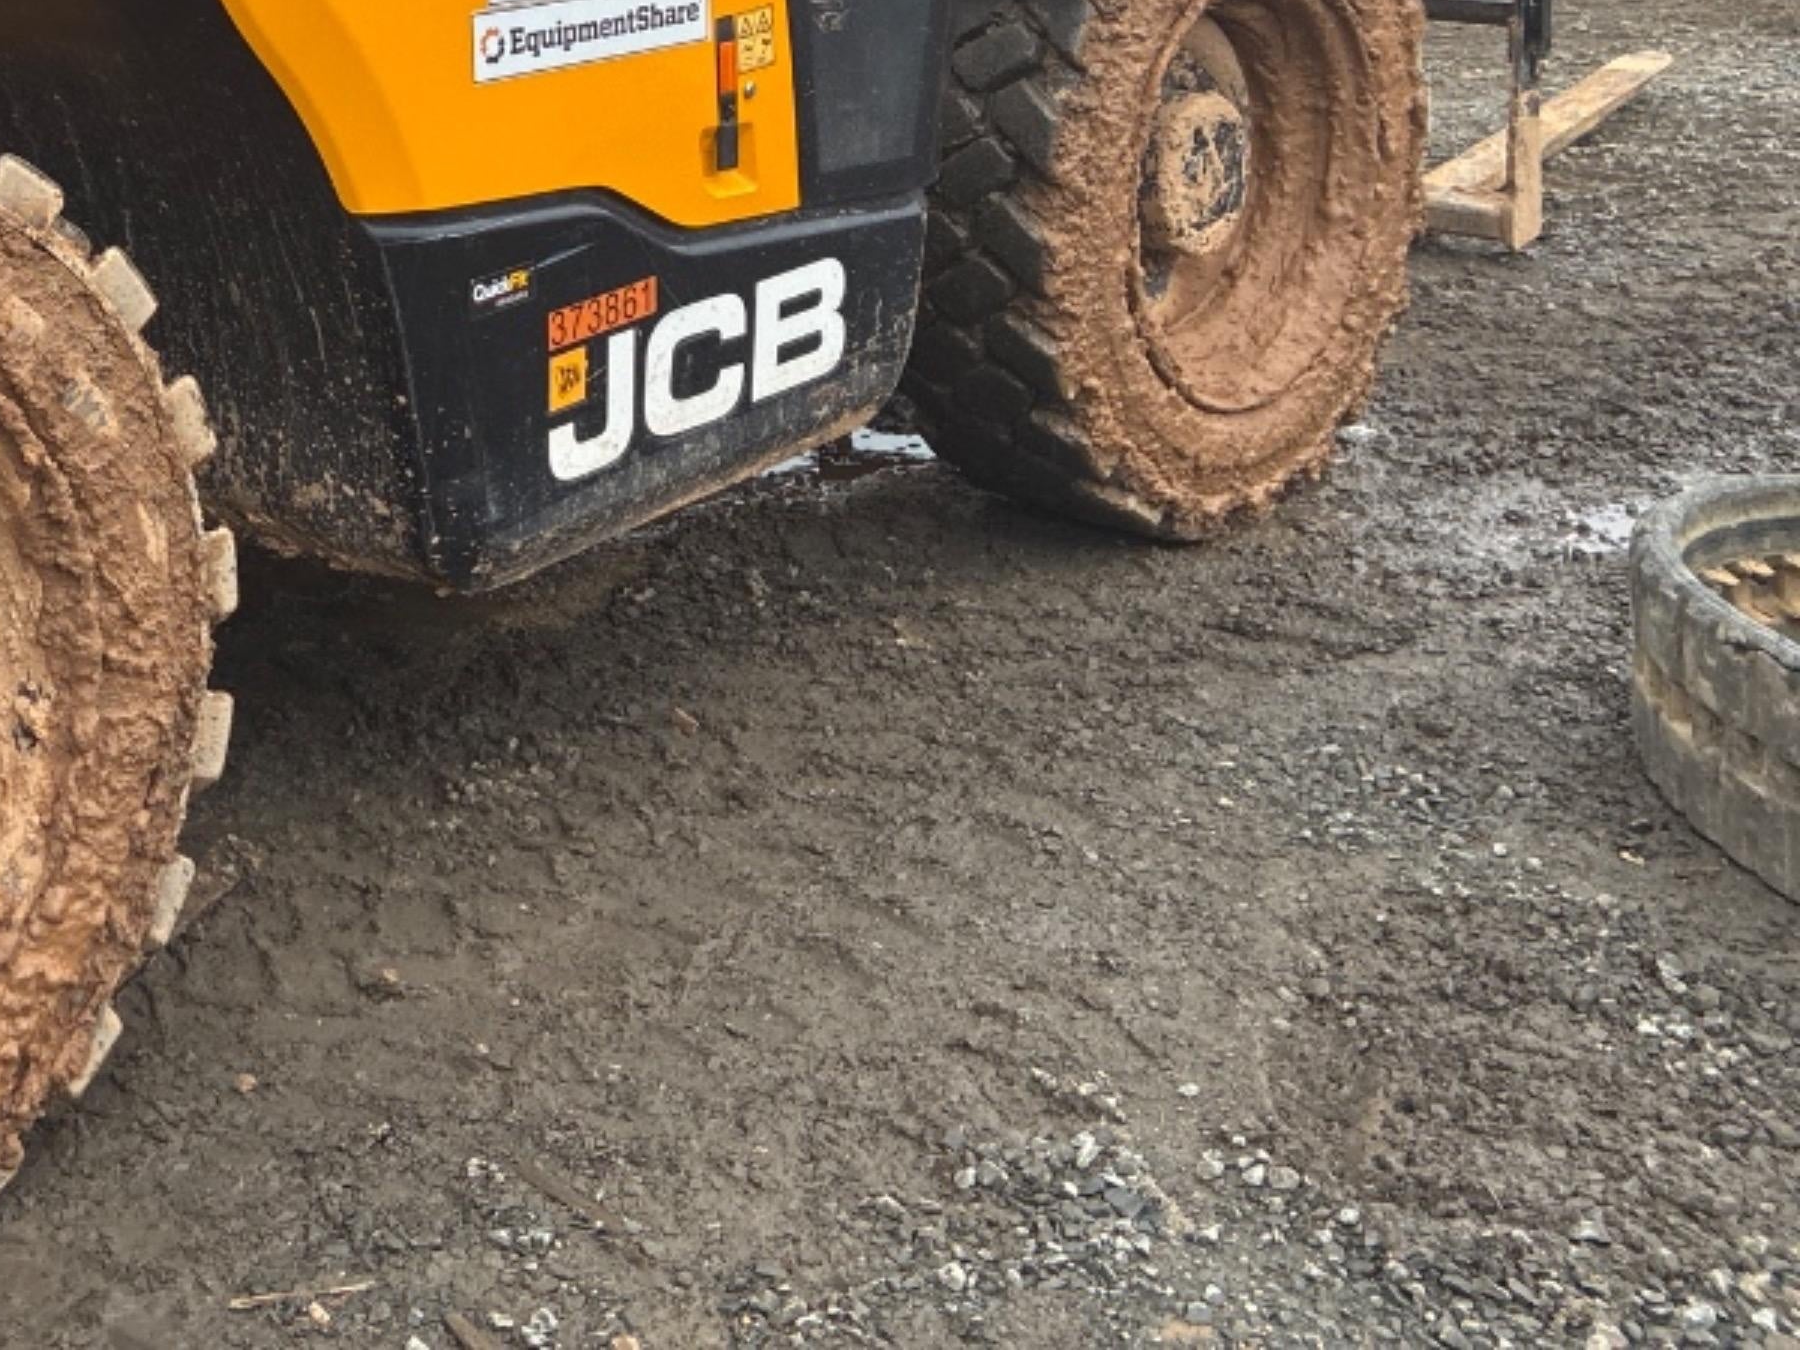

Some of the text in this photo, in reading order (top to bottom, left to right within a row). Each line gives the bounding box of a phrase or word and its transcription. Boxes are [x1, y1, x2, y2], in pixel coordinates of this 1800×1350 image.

[510, 0, 701, 57] EquipmentShare
[550, 284, 655, 349] 373861
[549, 257, 846, 481] JCB
